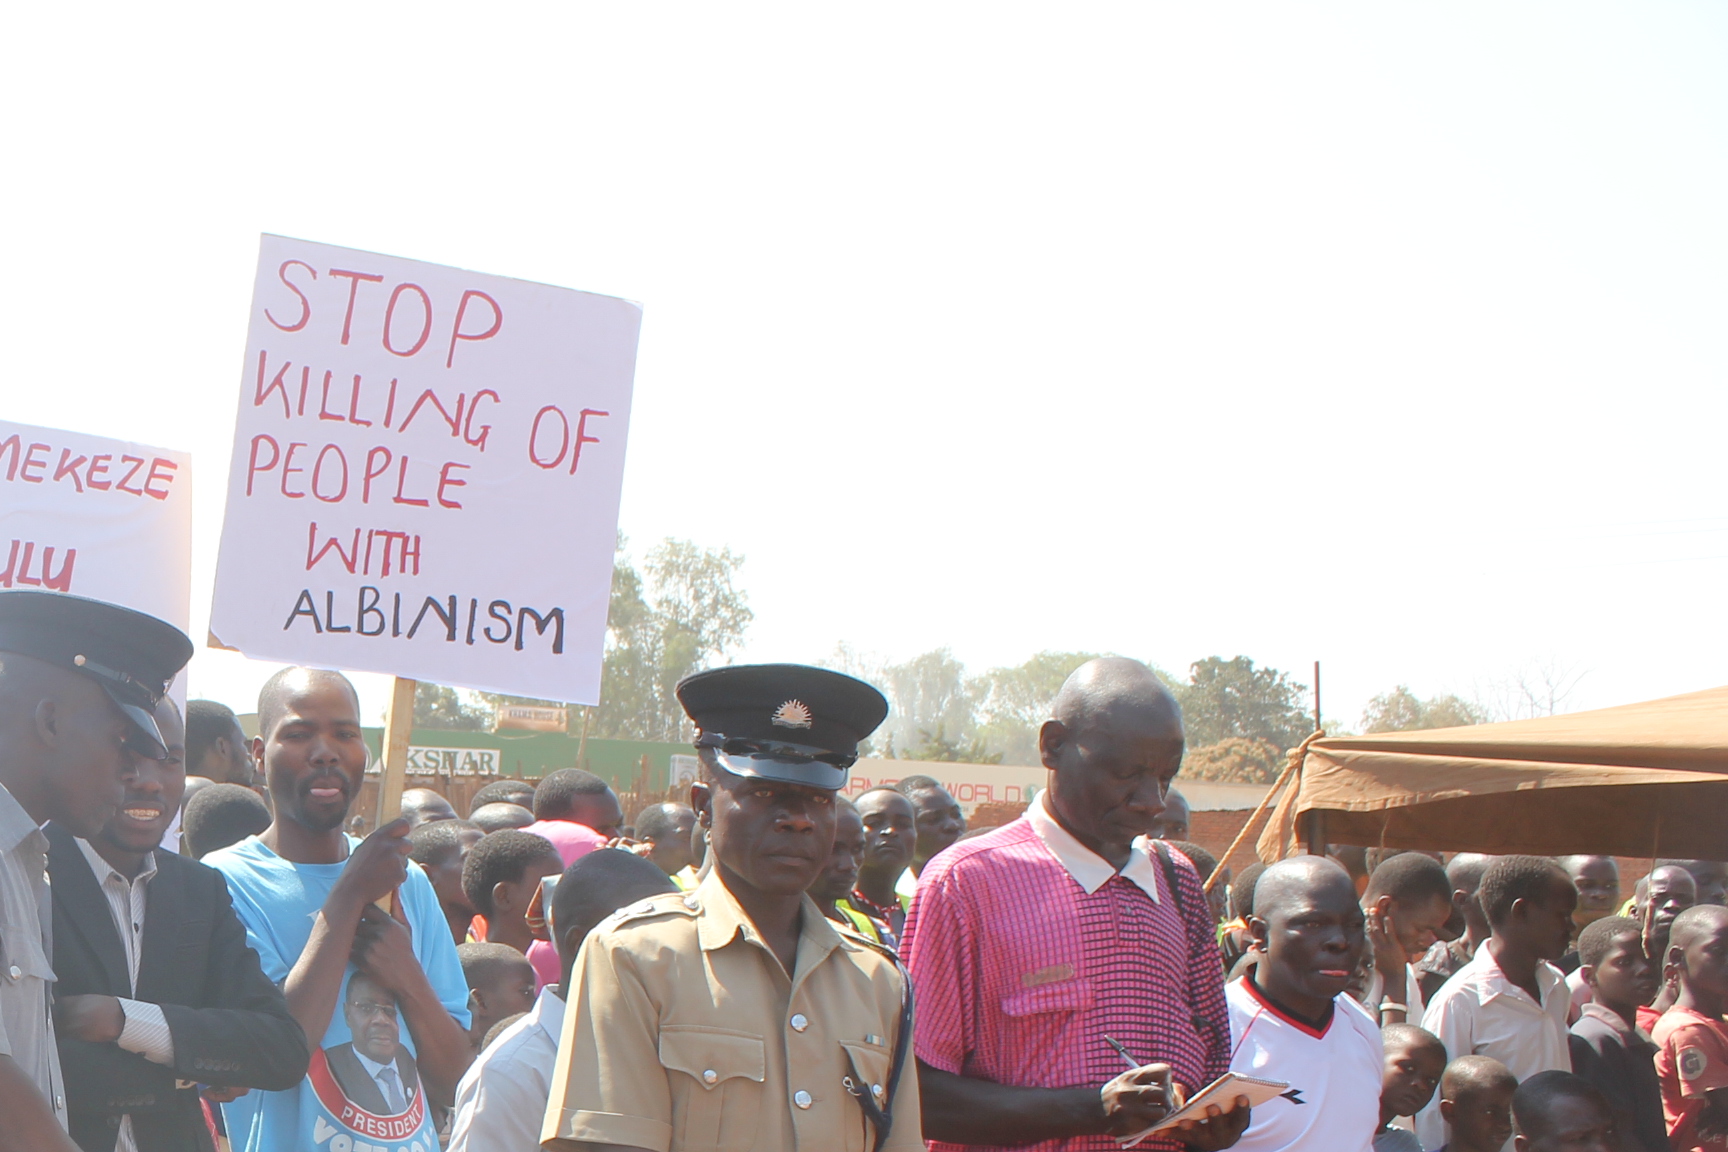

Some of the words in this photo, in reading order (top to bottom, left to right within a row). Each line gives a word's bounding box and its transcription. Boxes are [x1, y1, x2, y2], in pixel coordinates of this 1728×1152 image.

[264, 259, 503, 368] STOP
[254, 350, 501, 452] KILLING
[529, 405, 610, 476] OF
[246, 434, 471, 509] PEOPLE
[306, 522, 421, 578] WITH
[283, 586, 565, 654] ALBINISM
[341, 1104, 422, 1137] PRESIDENT
